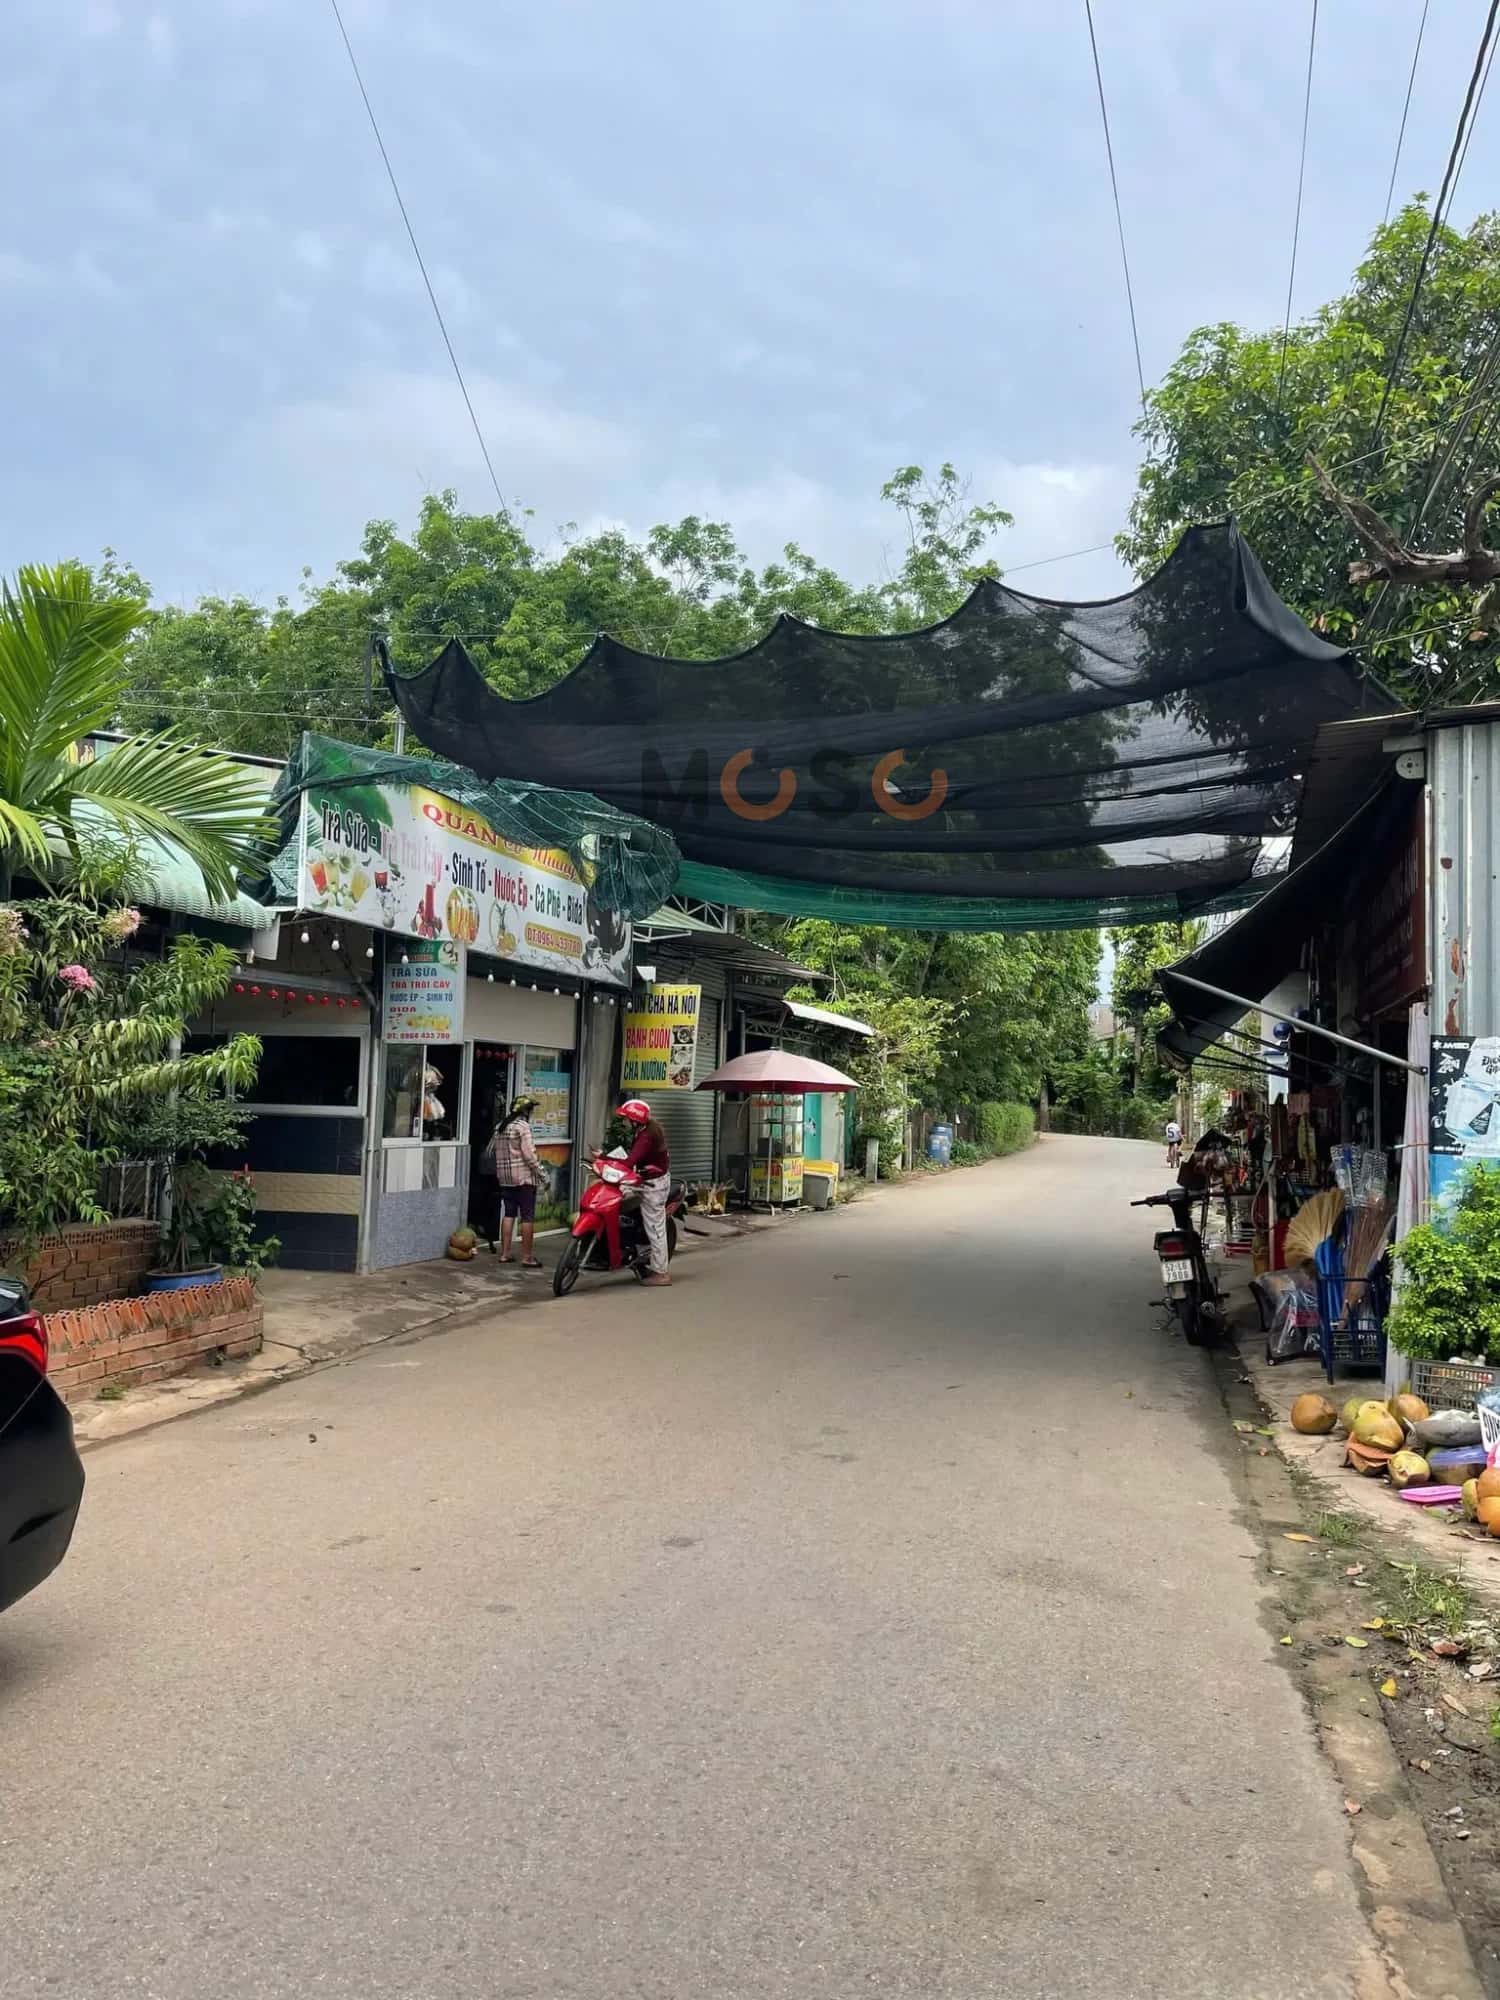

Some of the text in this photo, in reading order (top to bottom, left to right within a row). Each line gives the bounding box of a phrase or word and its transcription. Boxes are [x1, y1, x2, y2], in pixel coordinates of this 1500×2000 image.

[321, 800, 341, 844] Trà
[451, 851, 473, 888] Sinh
[422, 804, 497, 845] QUÁN
[1167, 1127, 1175, 1139] 5
